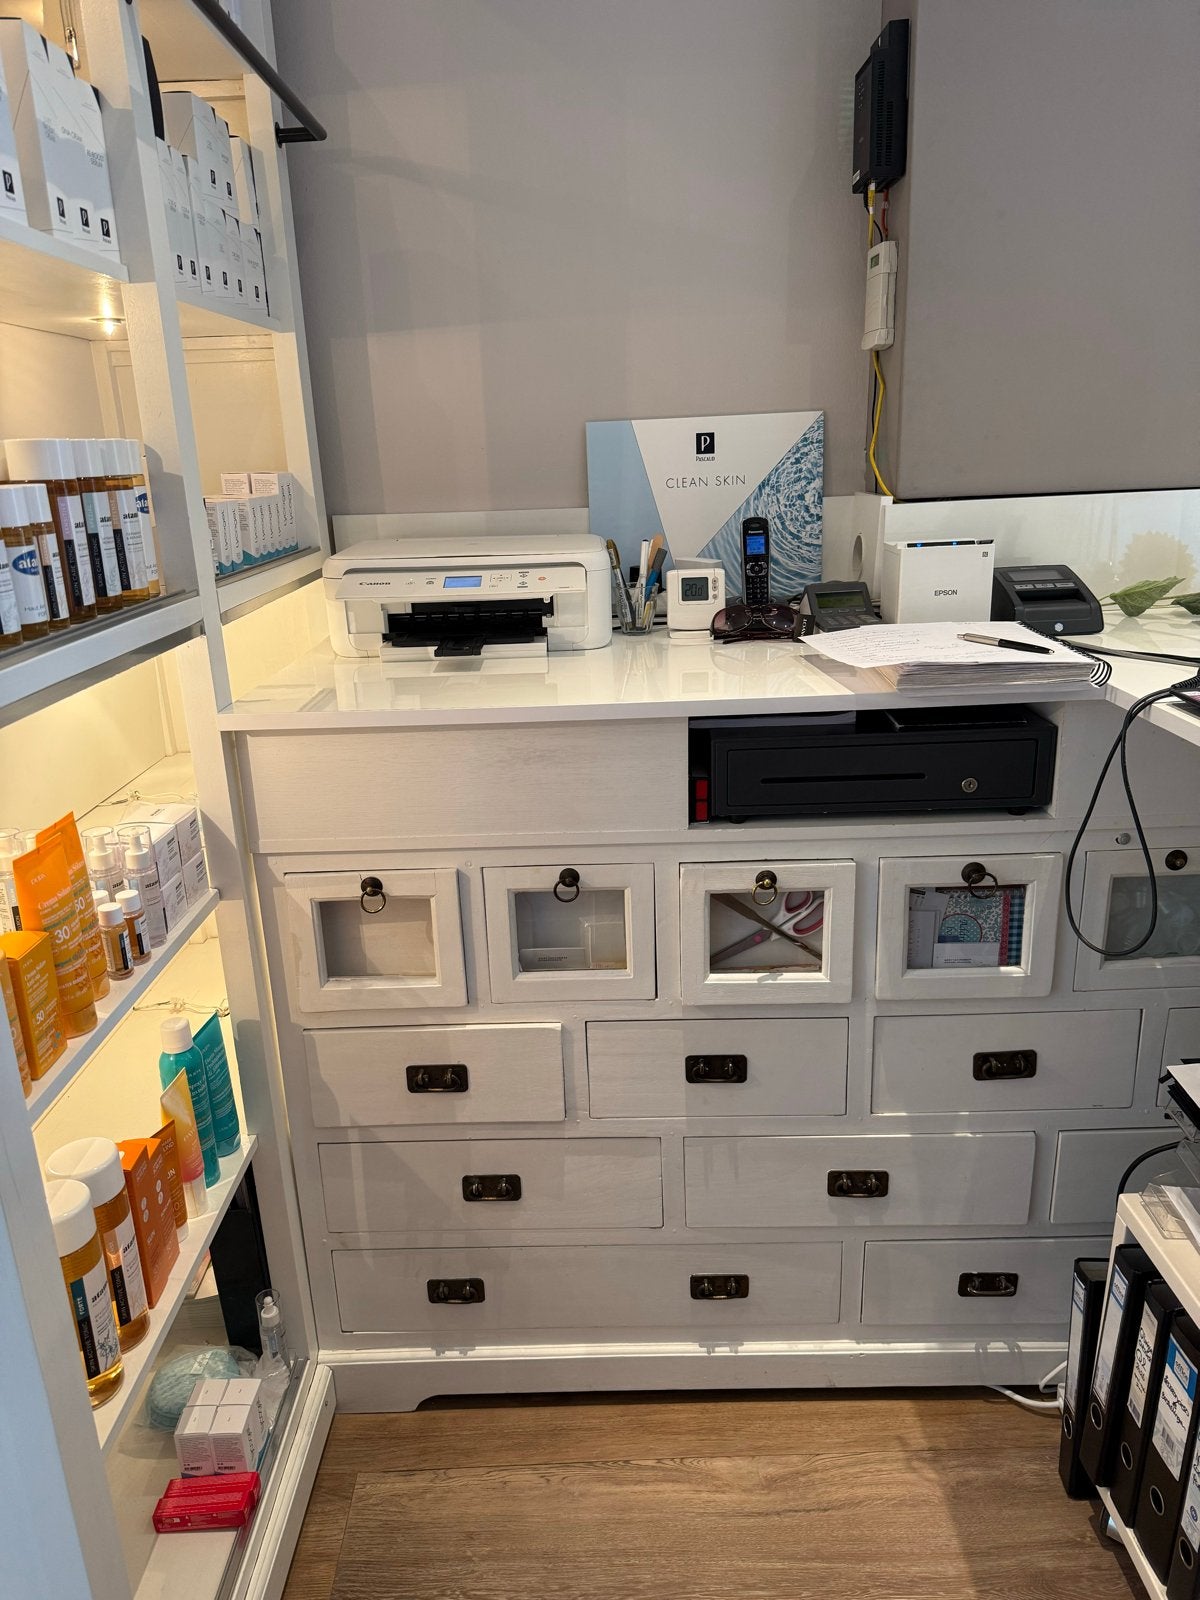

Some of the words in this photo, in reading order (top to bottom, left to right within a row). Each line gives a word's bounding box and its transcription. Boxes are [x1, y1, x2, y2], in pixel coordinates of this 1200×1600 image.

[665, 477, 709, 489] CLEAN
[715, 475, 746, 487] SKIN
[800, 618, 808, 637] AYOT
[54, 925, 71, 944] 30
[77, 1296, 86, 1315] FORTE
